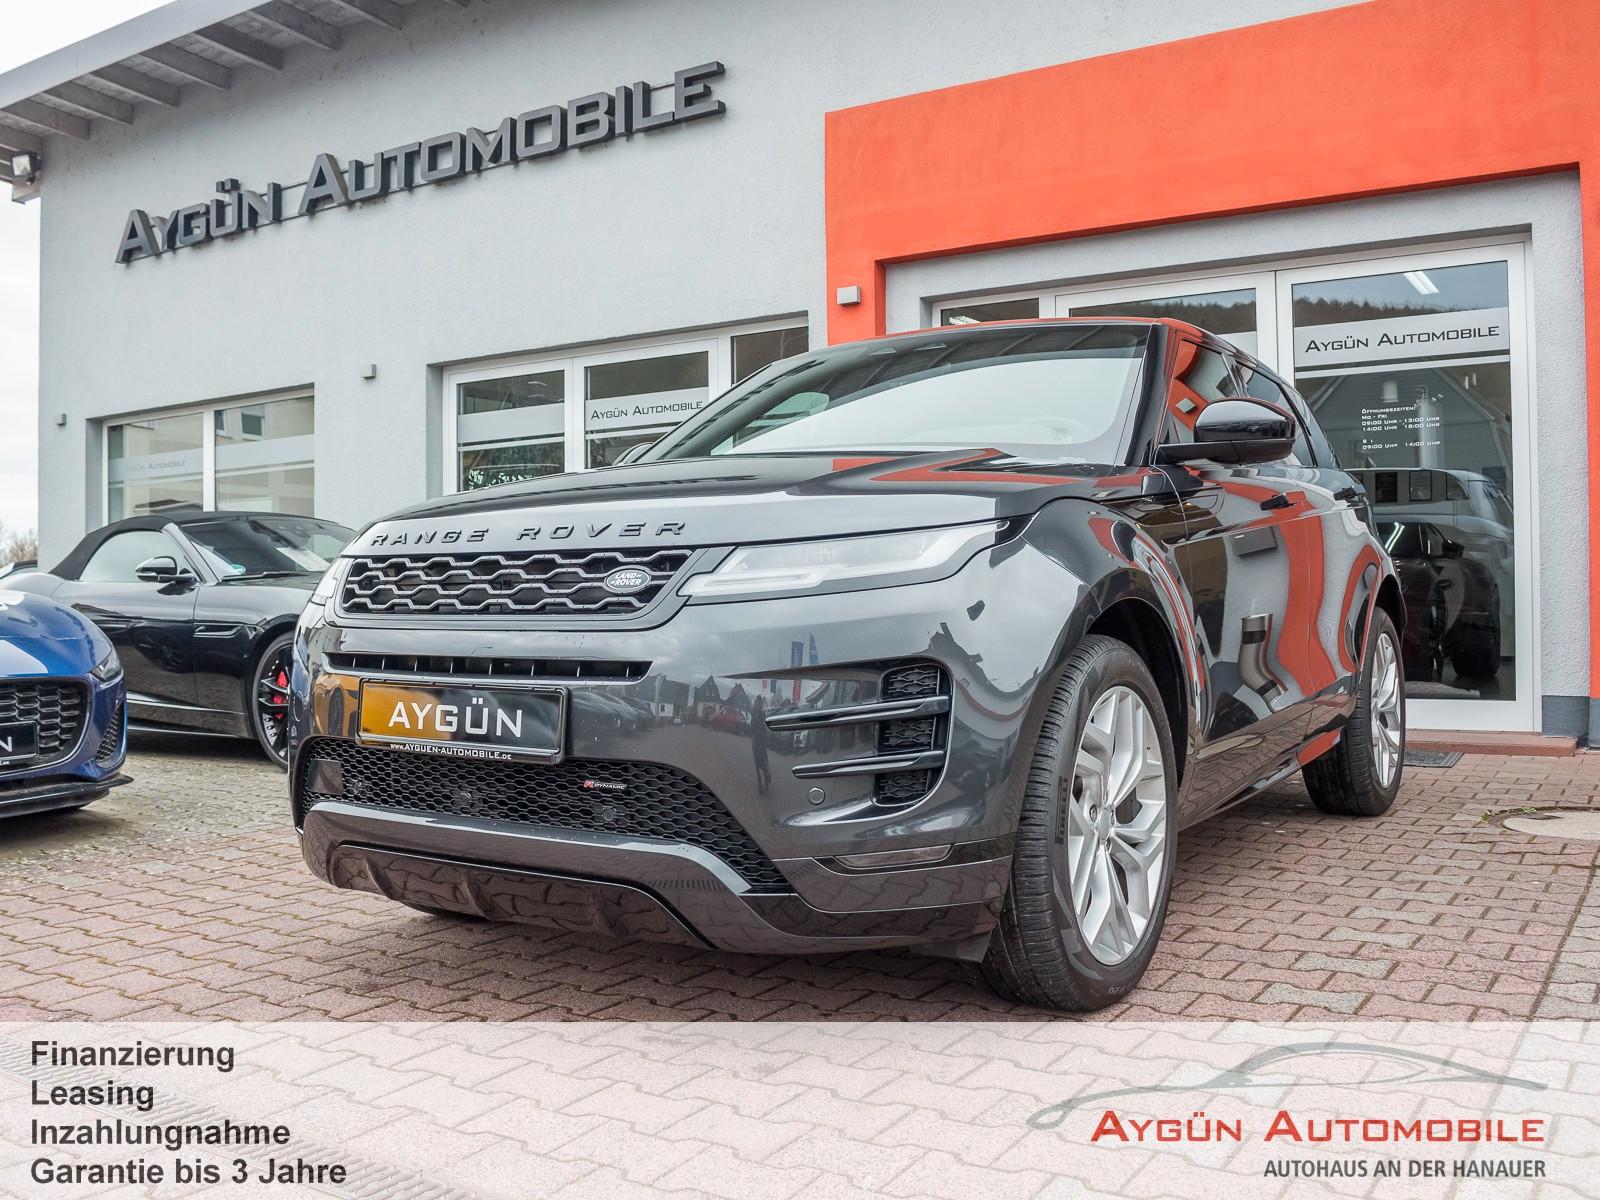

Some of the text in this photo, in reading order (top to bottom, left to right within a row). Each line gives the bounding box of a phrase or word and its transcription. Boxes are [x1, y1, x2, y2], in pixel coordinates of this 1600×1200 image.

[115, 61, 726, 264] AYGÜN AUTOMOBILE
[1305, 326, 1500, 353] AYGÜN AUTOMOBILE
[590, 401, 703, 420] AYGÜN AUTOMOBILE
[370, 520, 687, 547] RANGE ROVER
[614, 578, 642, 586] ROVER
[388, 697, 523, 738] AYGÜN
